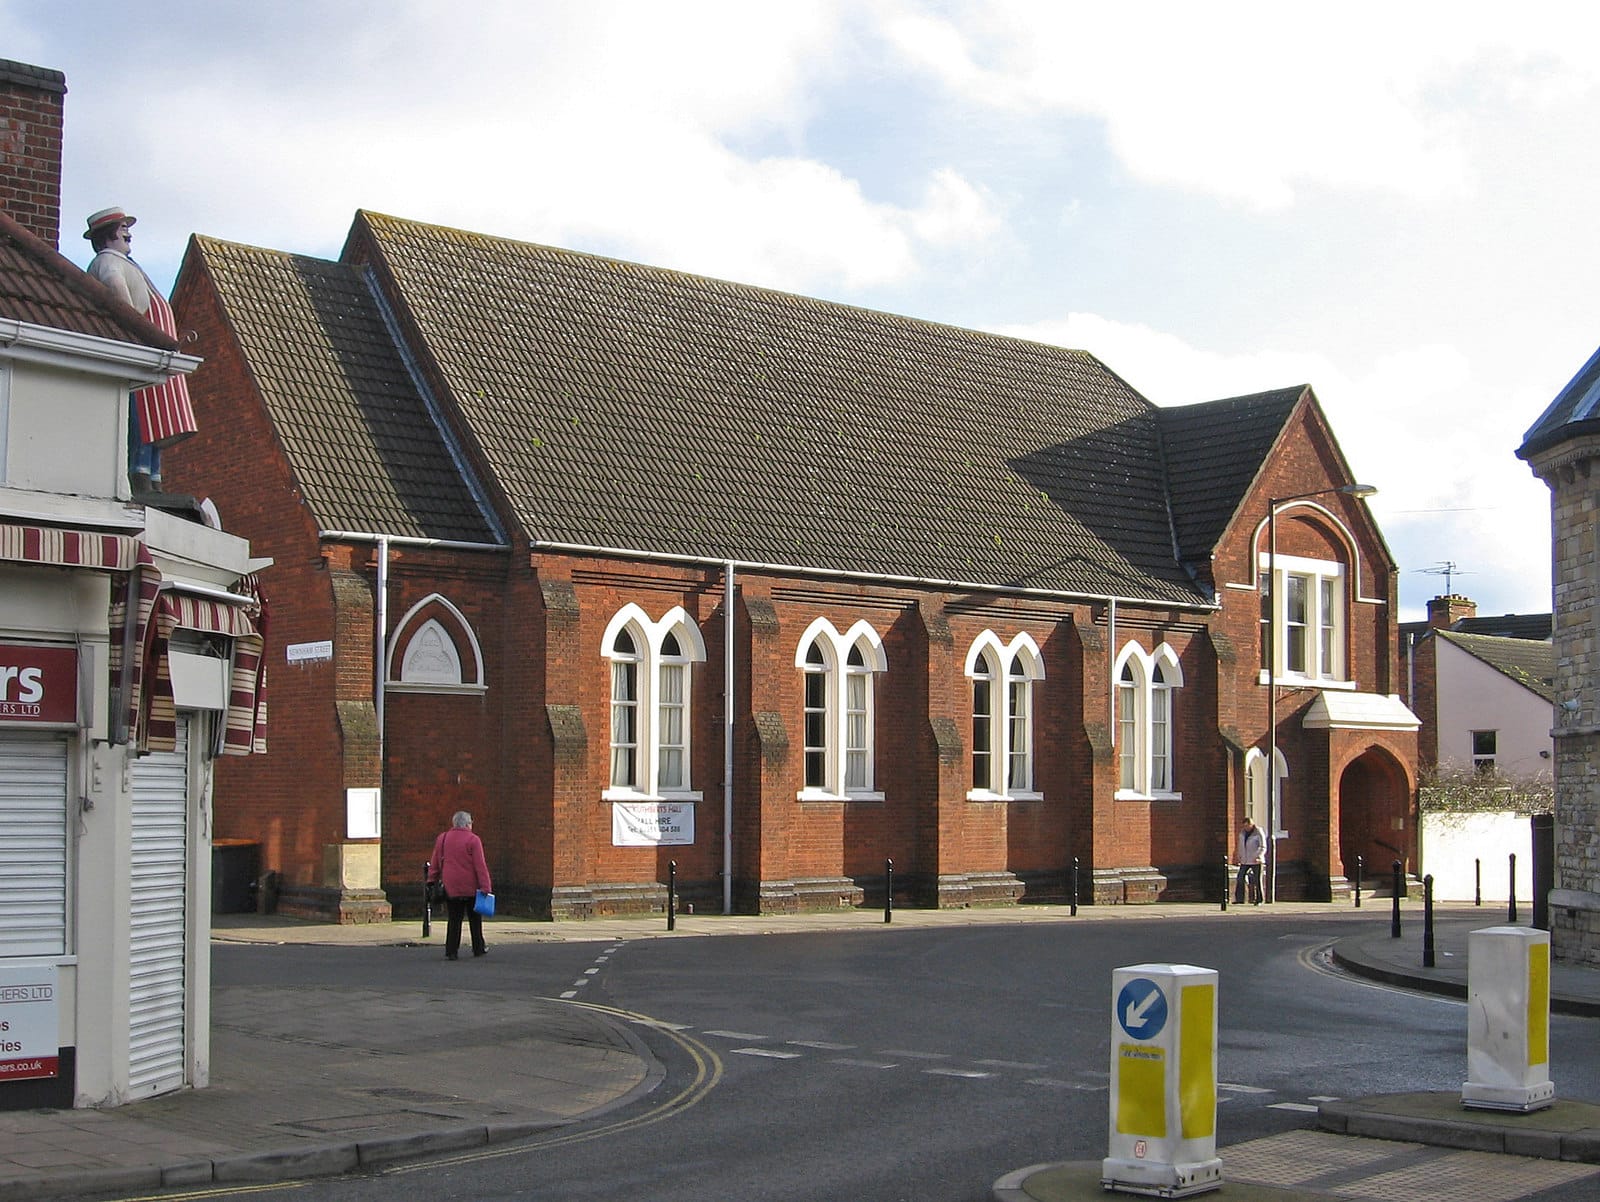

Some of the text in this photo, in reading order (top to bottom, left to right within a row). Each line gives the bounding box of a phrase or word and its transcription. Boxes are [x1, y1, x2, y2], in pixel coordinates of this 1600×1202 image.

[0, 704, 40, 715] RS LTD
[31, 987, 53, 999] LTD
